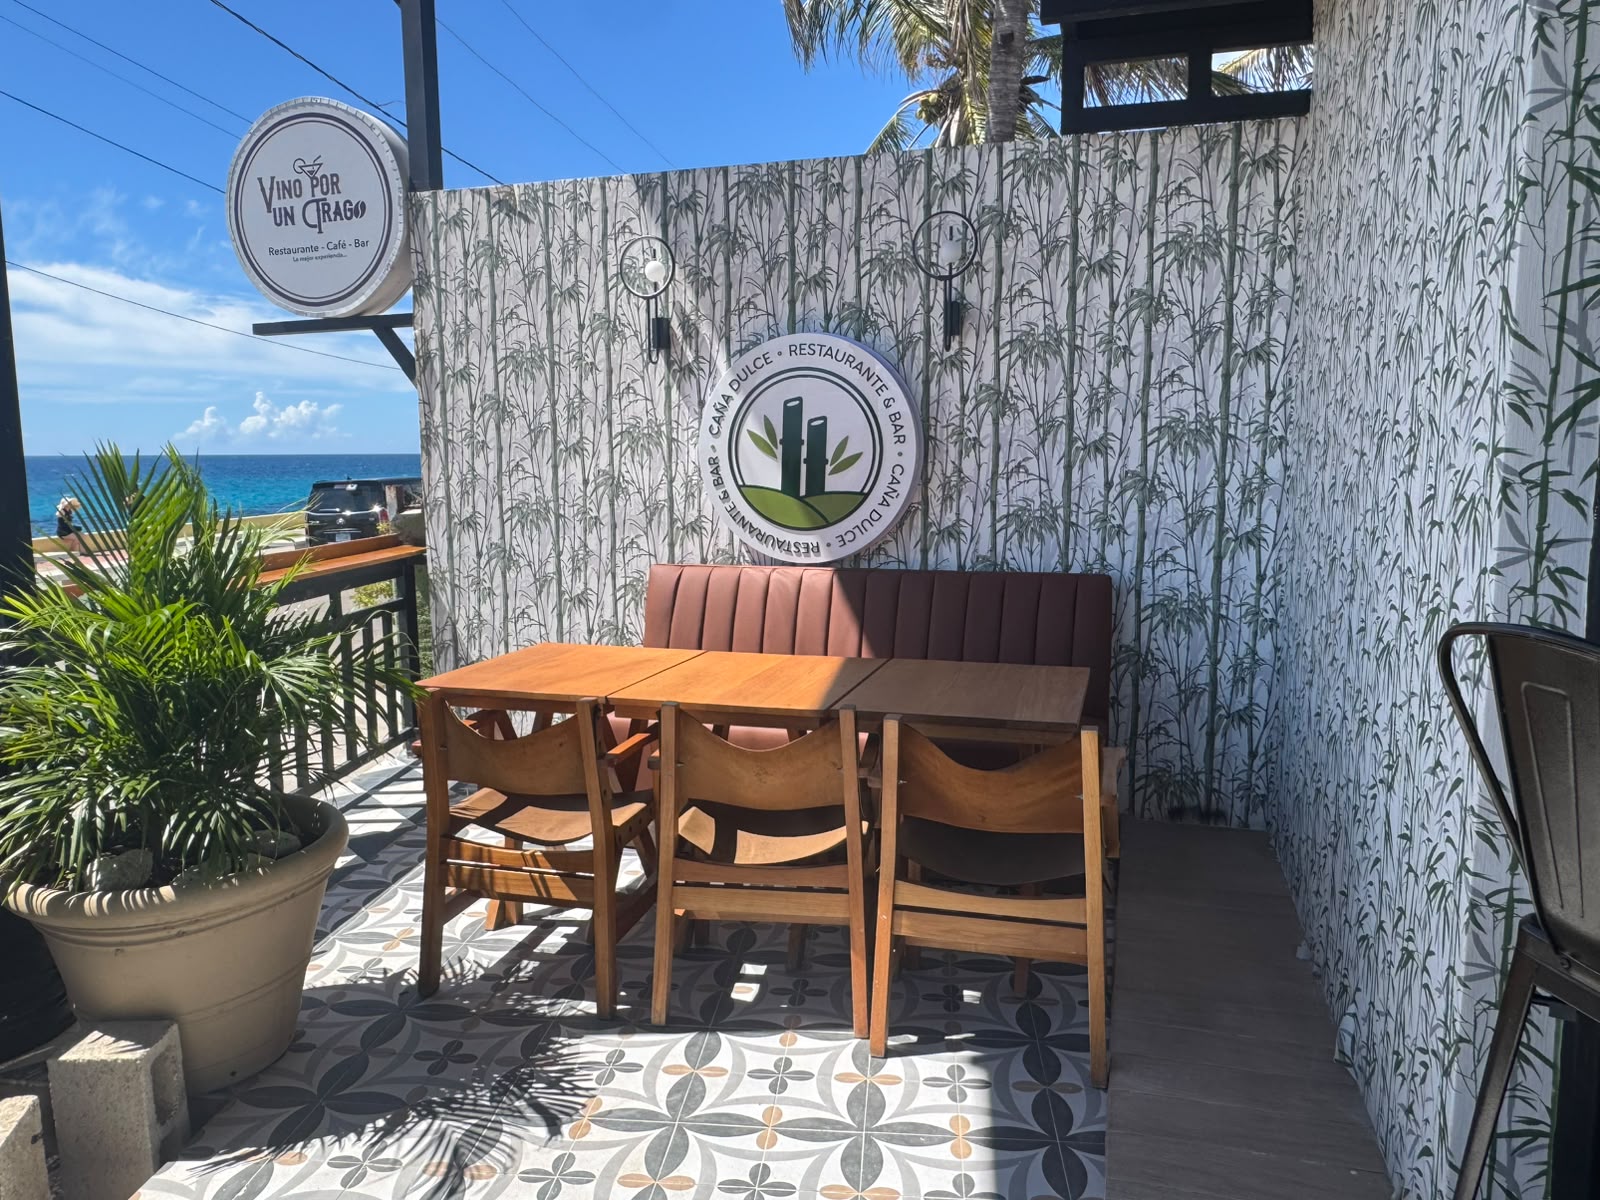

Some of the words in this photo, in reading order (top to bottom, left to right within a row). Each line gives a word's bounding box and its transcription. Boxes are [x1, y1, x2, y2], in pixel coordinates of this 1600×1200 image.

[257, 176, 303, 213] VINO
[310, 173, 342, 197] POR
[272, 206, 295, 227] UN
[302, 197, 366, 234] TRAGO
[268, 245, 319, 256] Restaurante
[326, 239, 346, 251] Café
[354, 238, 369, 248] Bar
[708, 394, 734, 437] CAÑA
[728, 351, 773, 392] DULCE
[788, 343, 889, 397] RESTAURANTE
[888, 411, 906, 445] BAR
[708, 456, 725, 488] BAR
[877, 463, 905, 508] CAÑA
[724, 501, 821, 554] RESTAURANTE
[835, 508, 883, 548] DULCE
